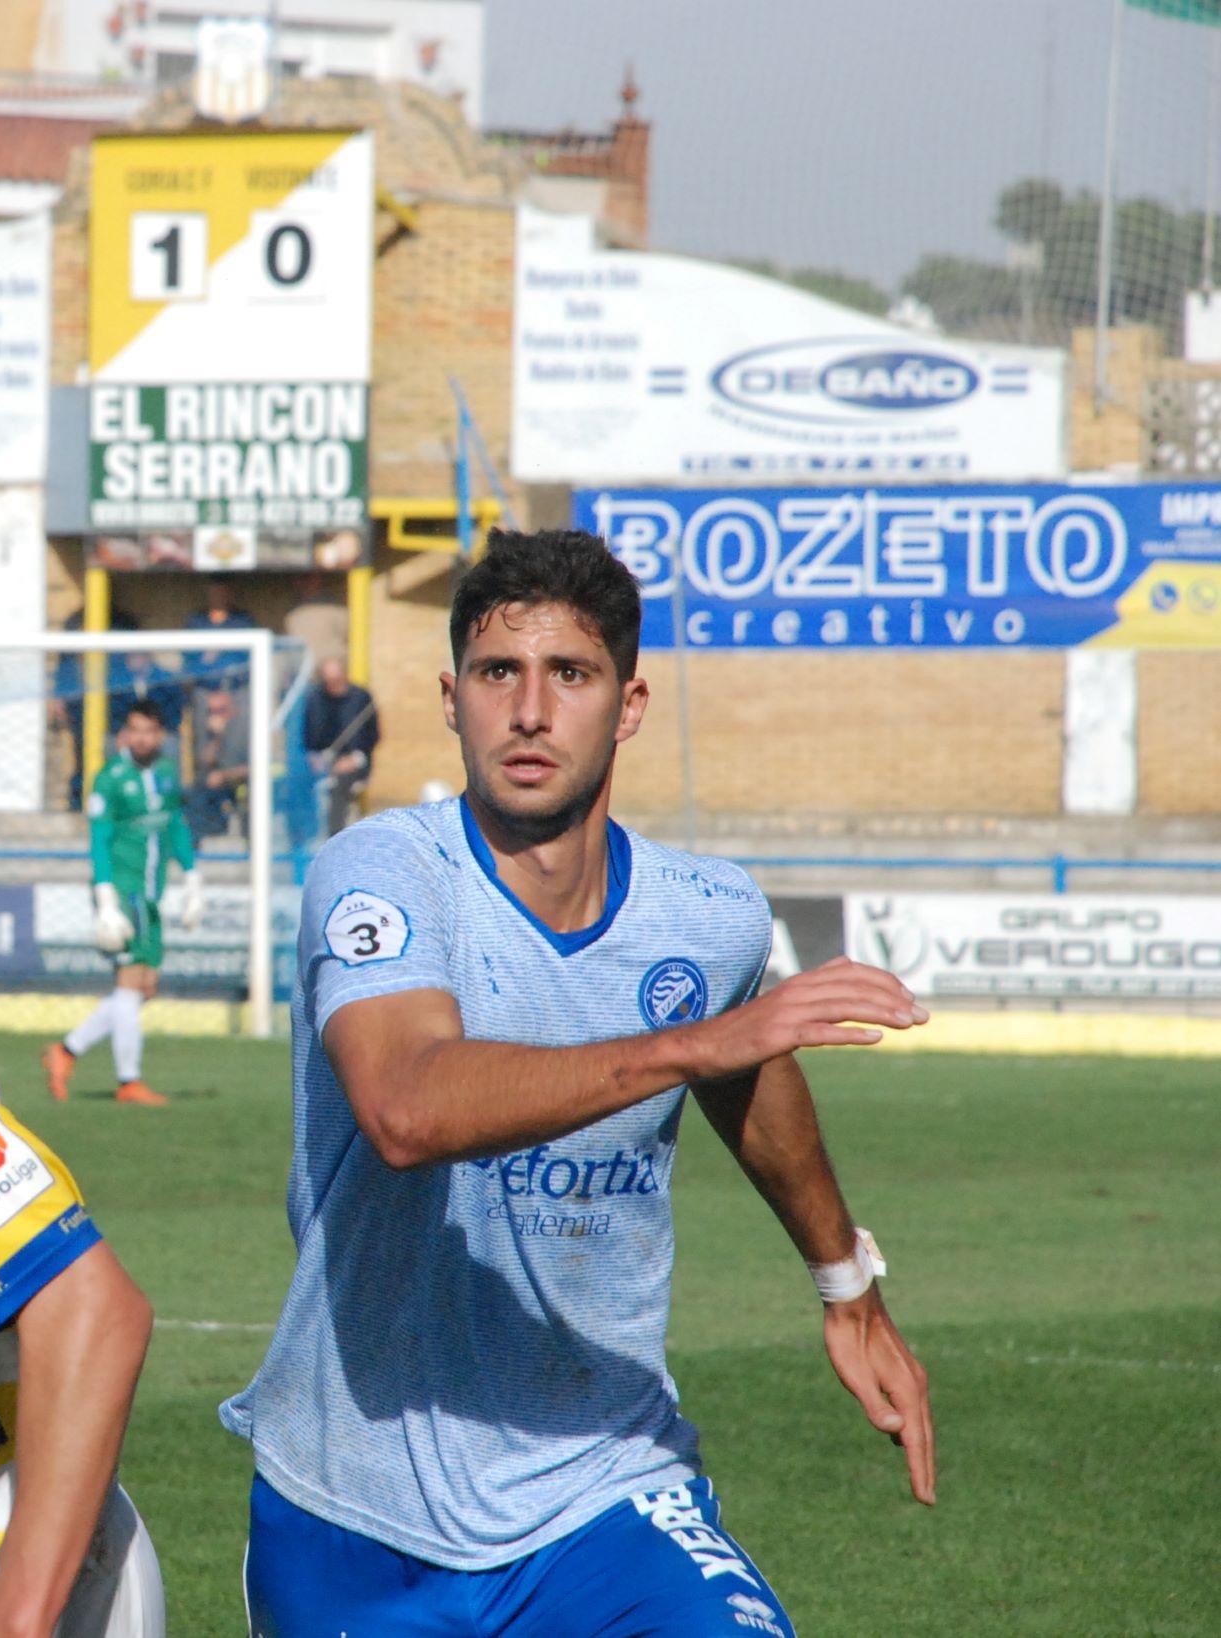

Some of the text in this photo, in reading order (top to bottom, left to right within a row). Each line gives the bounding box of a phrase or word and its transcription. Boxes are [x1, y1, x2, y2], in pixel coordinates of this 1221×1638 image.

[151, 223, 311, 288] 1 0
[90, 385, 154, 441] EL
[166, 385, 365, 441] RINCON
[103, 442, 352, 500] SERRANO
[593, 490, 1128, 600] BOZETO
[686, 599, 1026, 645] creativo
[999, 908, 1163, 933] GRUPO
[935, 937, 1221, 968] VERDUGO
[472, 1144, 660, 1199] efortia
